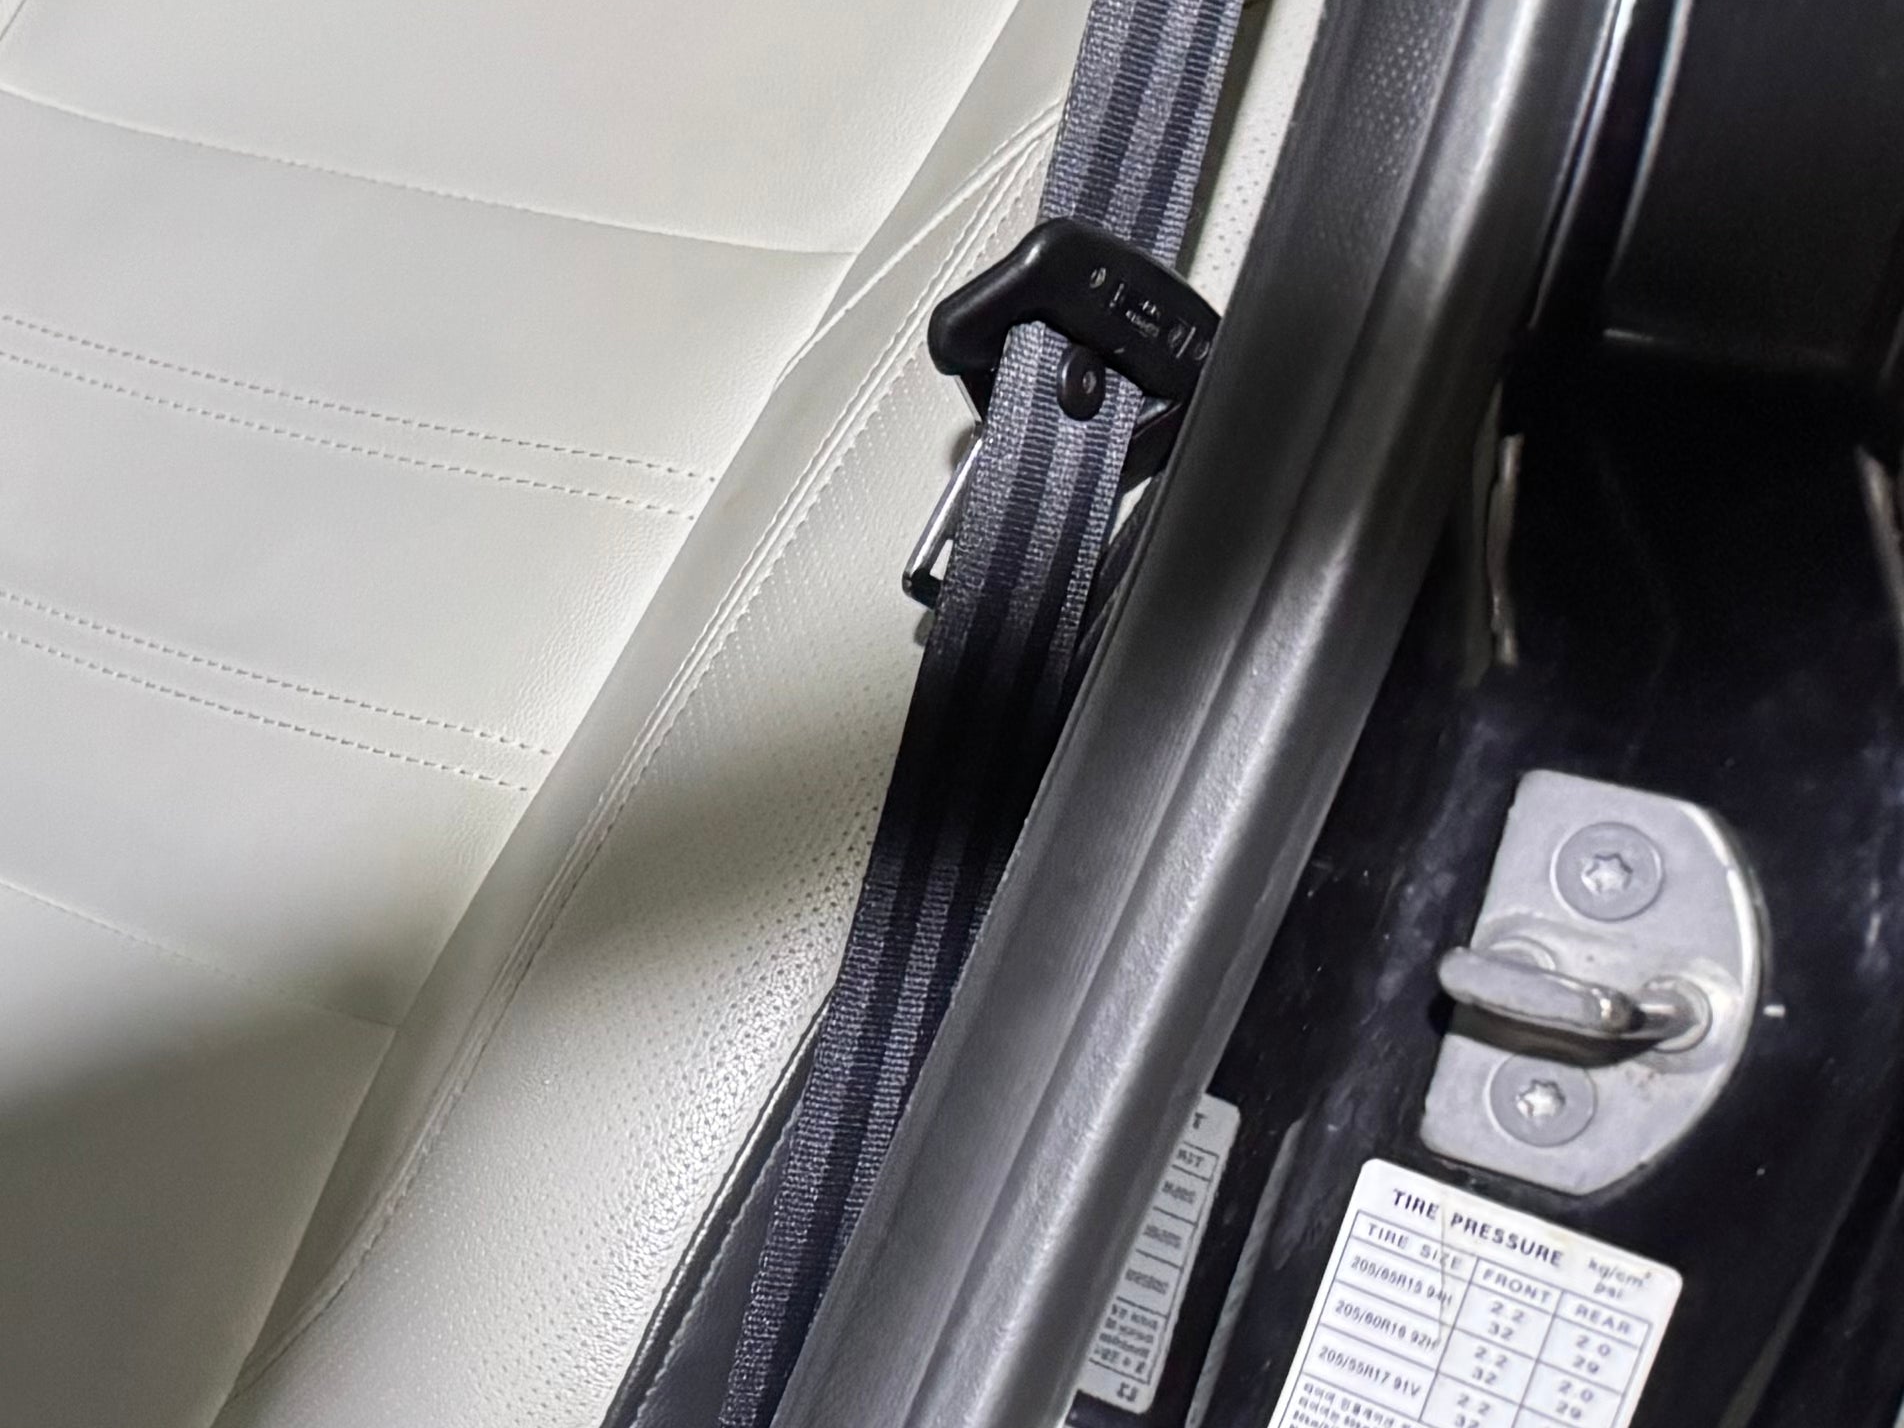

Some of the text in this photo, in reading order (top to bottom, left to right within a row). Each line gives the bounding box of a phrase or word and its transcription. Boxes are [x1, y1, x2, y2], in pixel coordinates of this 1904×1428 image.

[1389, 1188, 1564, 1267] TIRE PRESSURE
[1366, 1223, 1464, 1271] TIRE SIZE
[1482, 1268, 1551, 1304] FRONT
[1593, 1281, 1623, 1302] psi
[1574, 1303, 1632, 1335] REAR
[1487, 1322, 1514, 1342] 32
[1471, 1367, 1497, 1386] 32
[1571, 1356, 1600, 1375] 29
[1392, 1374, 1422, 1397] 91V
[1555, 1401, 1583, 1420] 29
